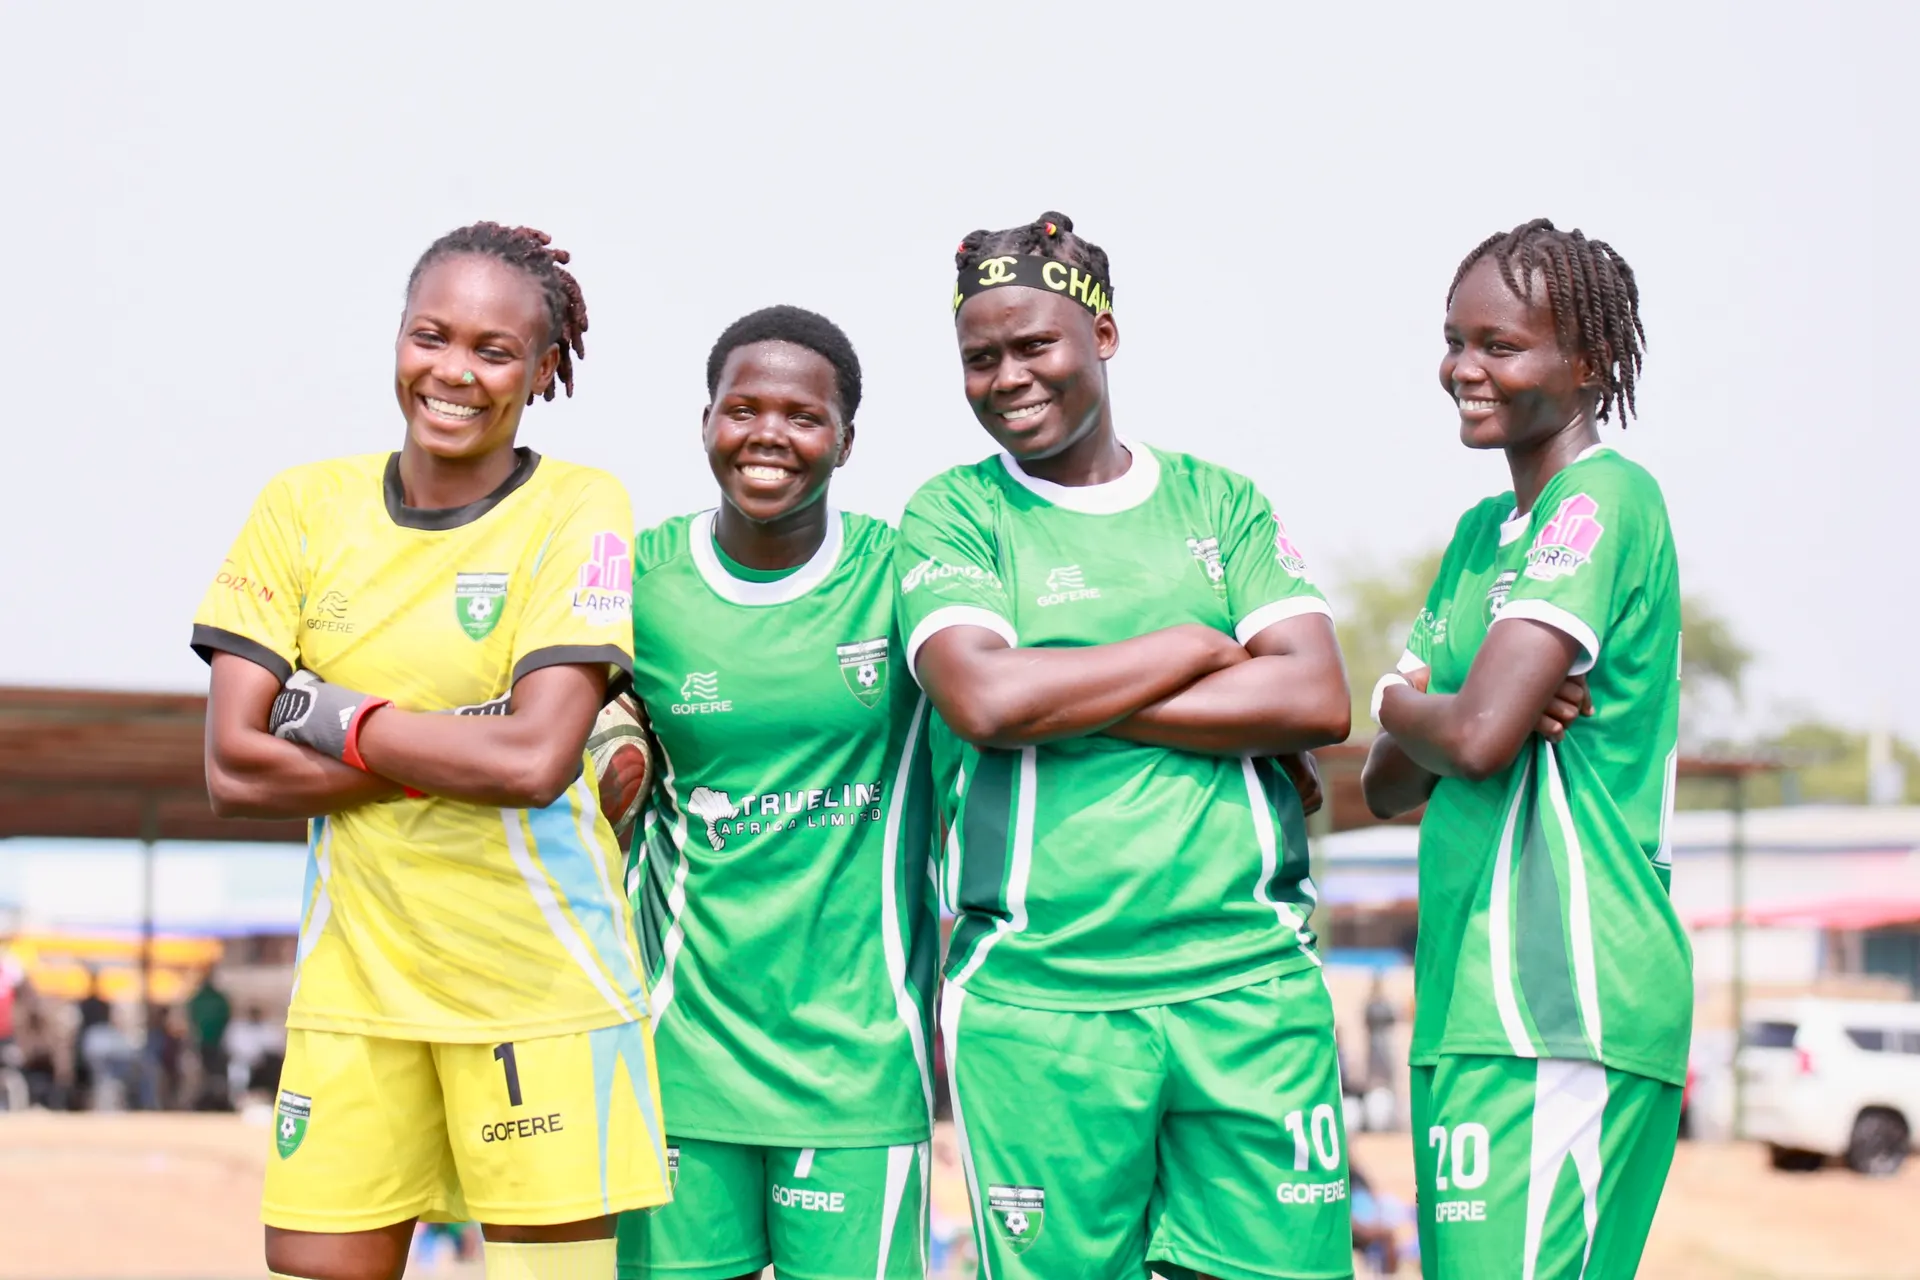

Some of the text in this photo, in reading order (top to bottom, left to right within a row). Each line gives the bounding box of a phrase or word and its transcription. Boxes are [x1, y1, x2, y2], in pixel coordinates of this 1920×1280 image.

[1037, 588, 1101, 606] GOFERE
[306, 618, 355, 634] GOFERE
[671, 700, 733, 715] GOFERE
[741, 780, 881, 816] TRUELINE
[493, 1042, 523, 1107] 1
[482, 1112, 563, 1143] GOFERE
[1284, 1103, 1340, 1172] 10
[1429, 1122, 1490, 1191] 20
[772, 1184, 845, 1212] GOFERE
[1276, 1179, 1346, 1204] GOFERE
[1436, 1200, 1487, 1223] OFERE
